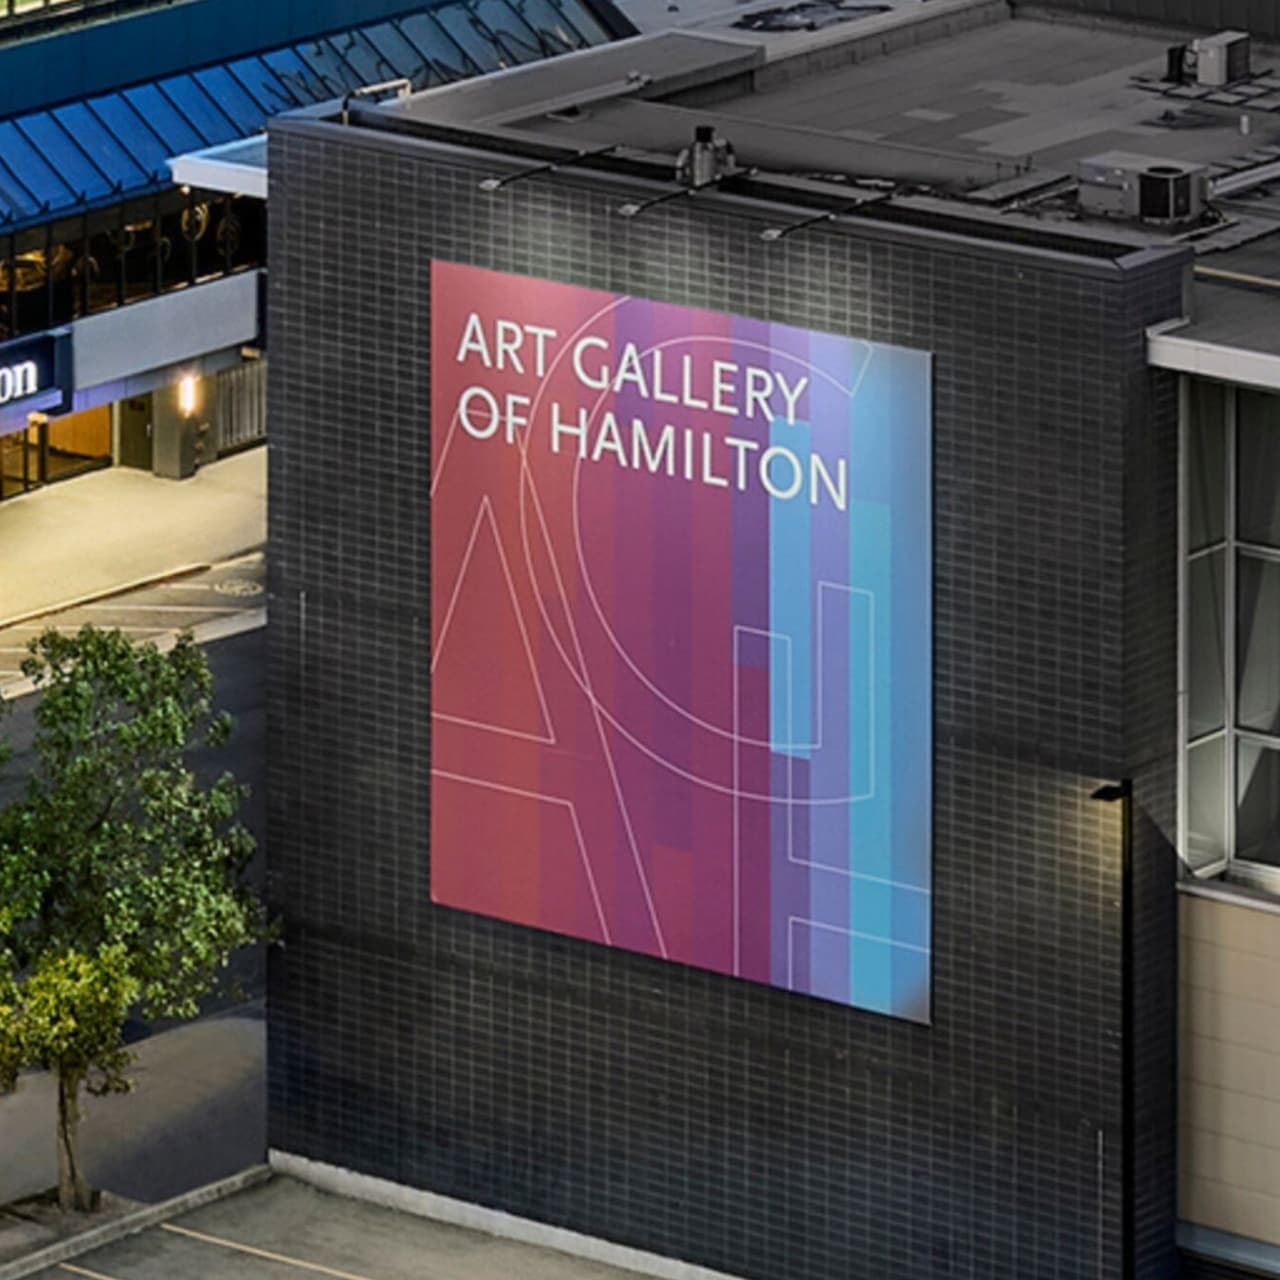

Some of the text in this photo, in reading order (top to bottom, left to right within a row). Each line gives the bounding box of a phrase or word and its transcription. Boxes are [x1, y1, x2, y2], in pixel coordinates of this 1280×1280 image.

[456, 312, 809, 423] ART GALLERY
[457, 387, 848, 511] OF HAMILTON
